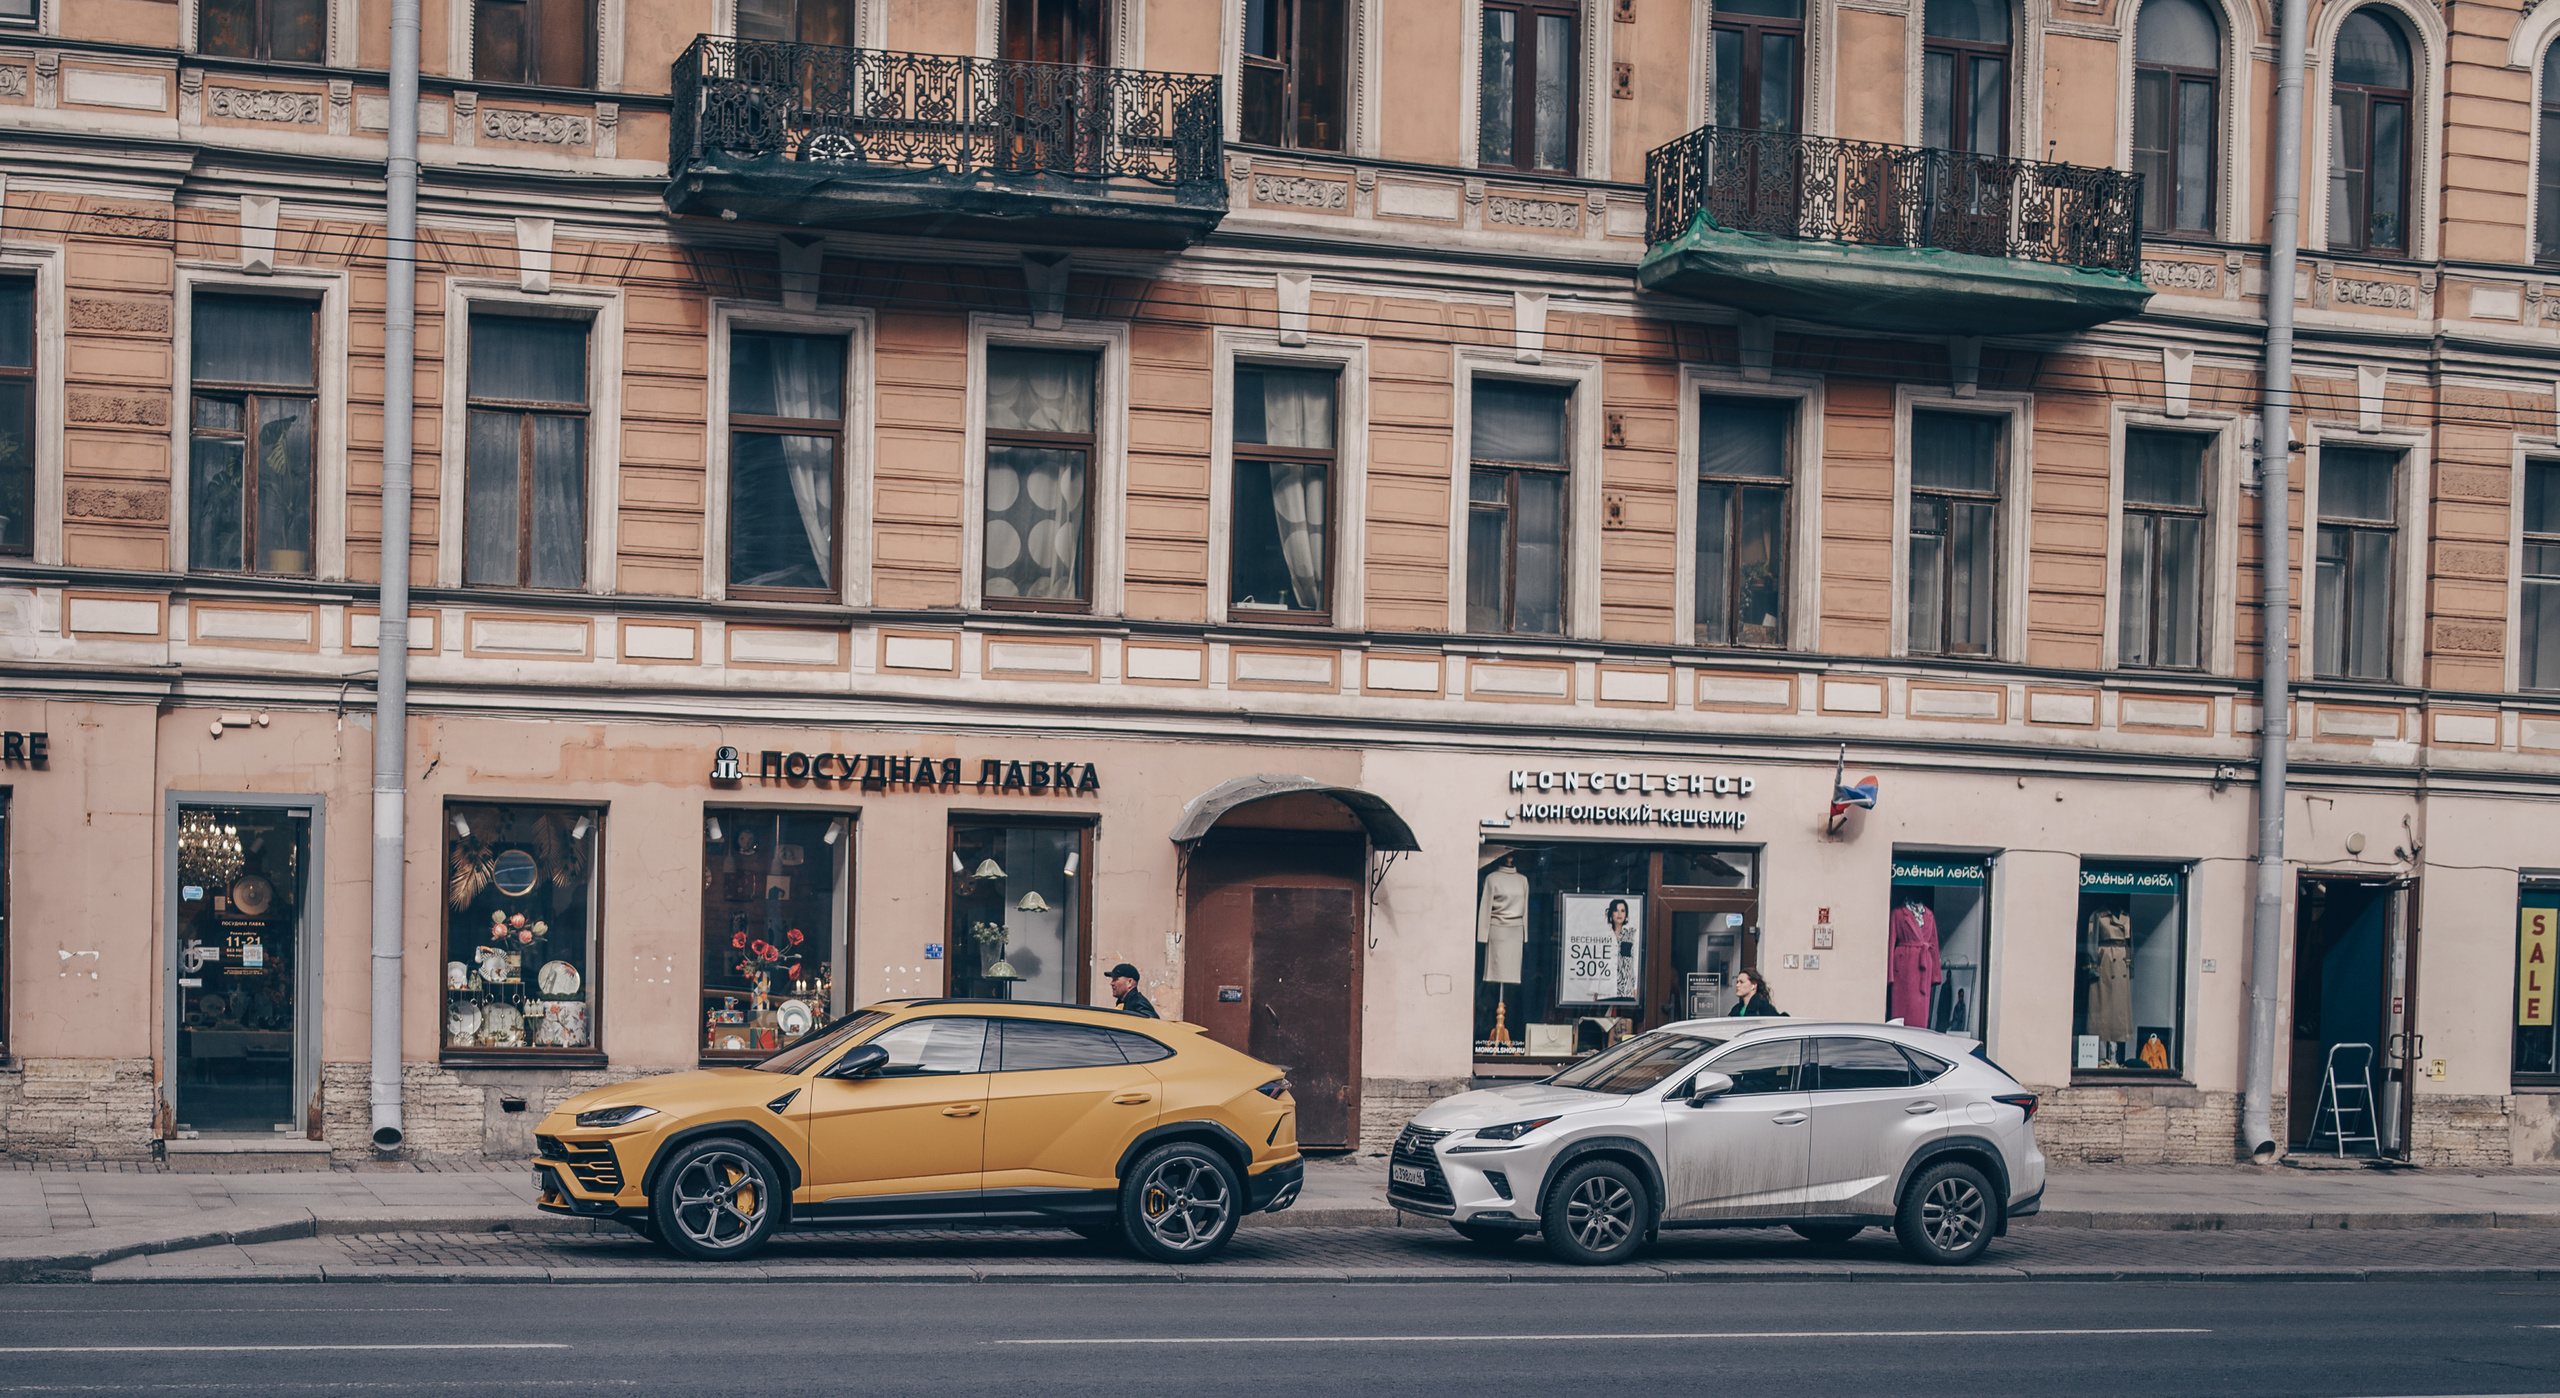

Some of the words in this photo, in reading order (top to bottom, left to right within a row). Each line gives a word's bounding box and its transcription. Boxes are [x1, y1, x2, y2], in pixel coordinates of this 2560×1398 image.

[4, 731, 48, 760] RE
[761, 750, 961, 787] ПОСУДНАЯ
[977, 759, 1101, 789] ЛАВКА
[1510, 770, 1756, 795] MONGOLSHOP
[1520, 803, 1653, 823] монгольский
[1659, 808, 1748, 829] кашемир
[1947, 865, 1985, 879] лейбл
[2137, 874, 2174, 887] лейбл
[226, 936, 261, 947] 11-21
[1570, 935, 1613, 944] ВЕСЕННИЙ
[1570, 944, 1612, 960] SALE
[1570, 960, 1611, 977] -30%
[2527, 914, 2545, 1019] SALE
